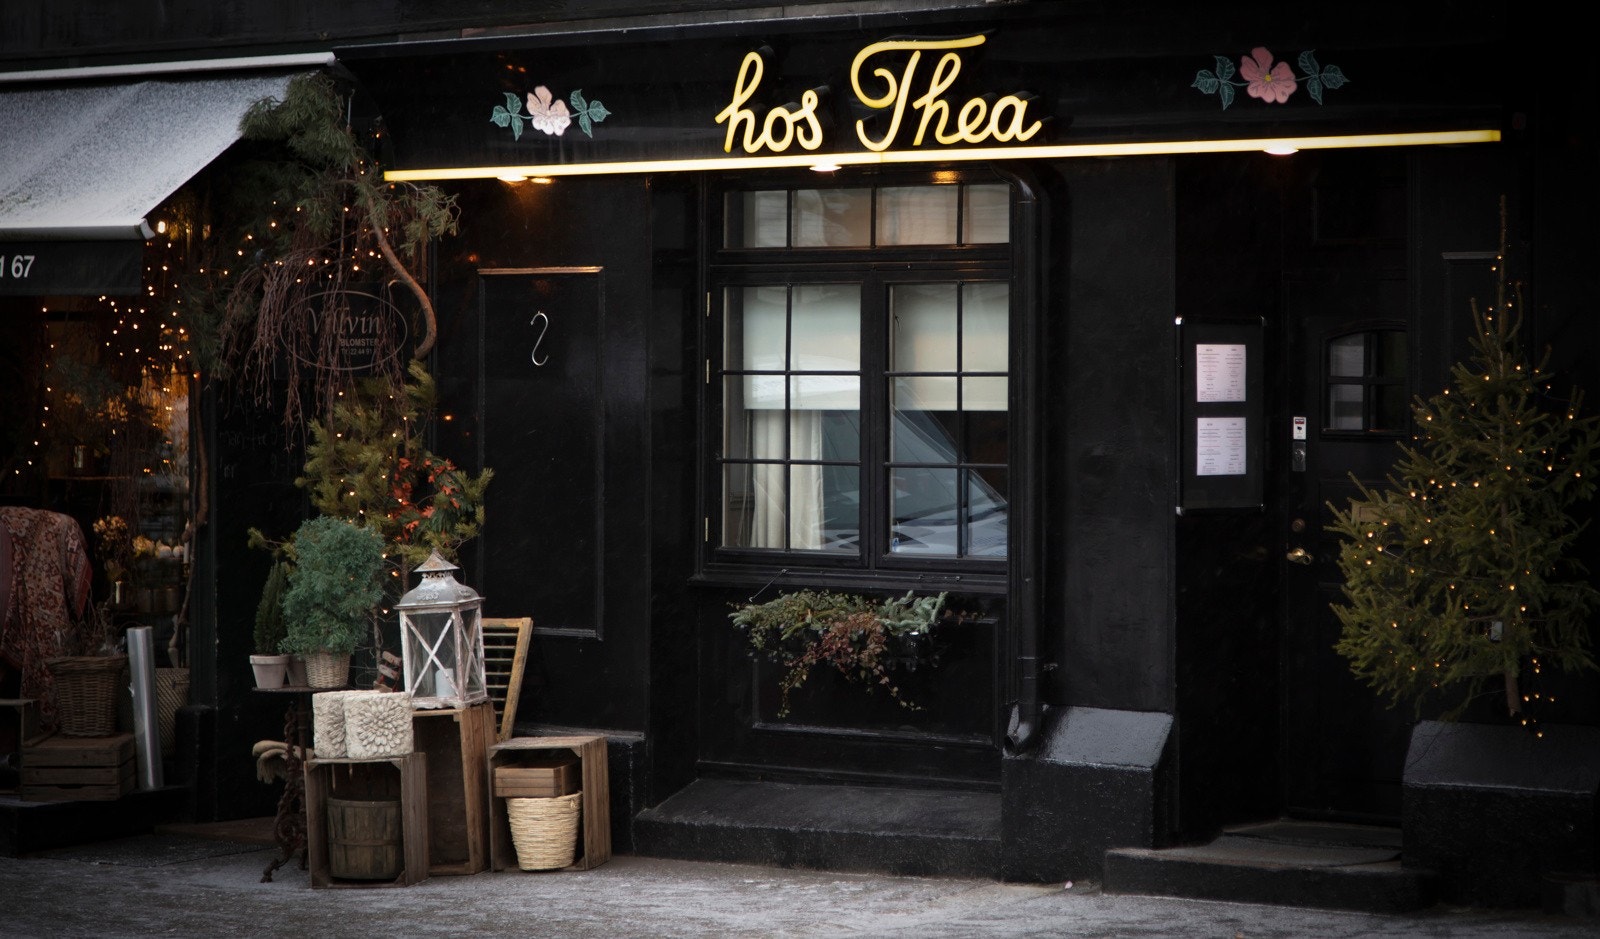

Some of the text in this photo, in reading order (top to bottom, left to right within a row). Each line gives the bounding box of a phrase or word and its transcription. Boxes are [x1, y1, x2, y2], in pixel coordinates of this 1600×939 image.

[714, 34, 1042, 153] hos Thea
[11, 254, 36, 279] 67
[304, 307, 382, 334] Vllvin
